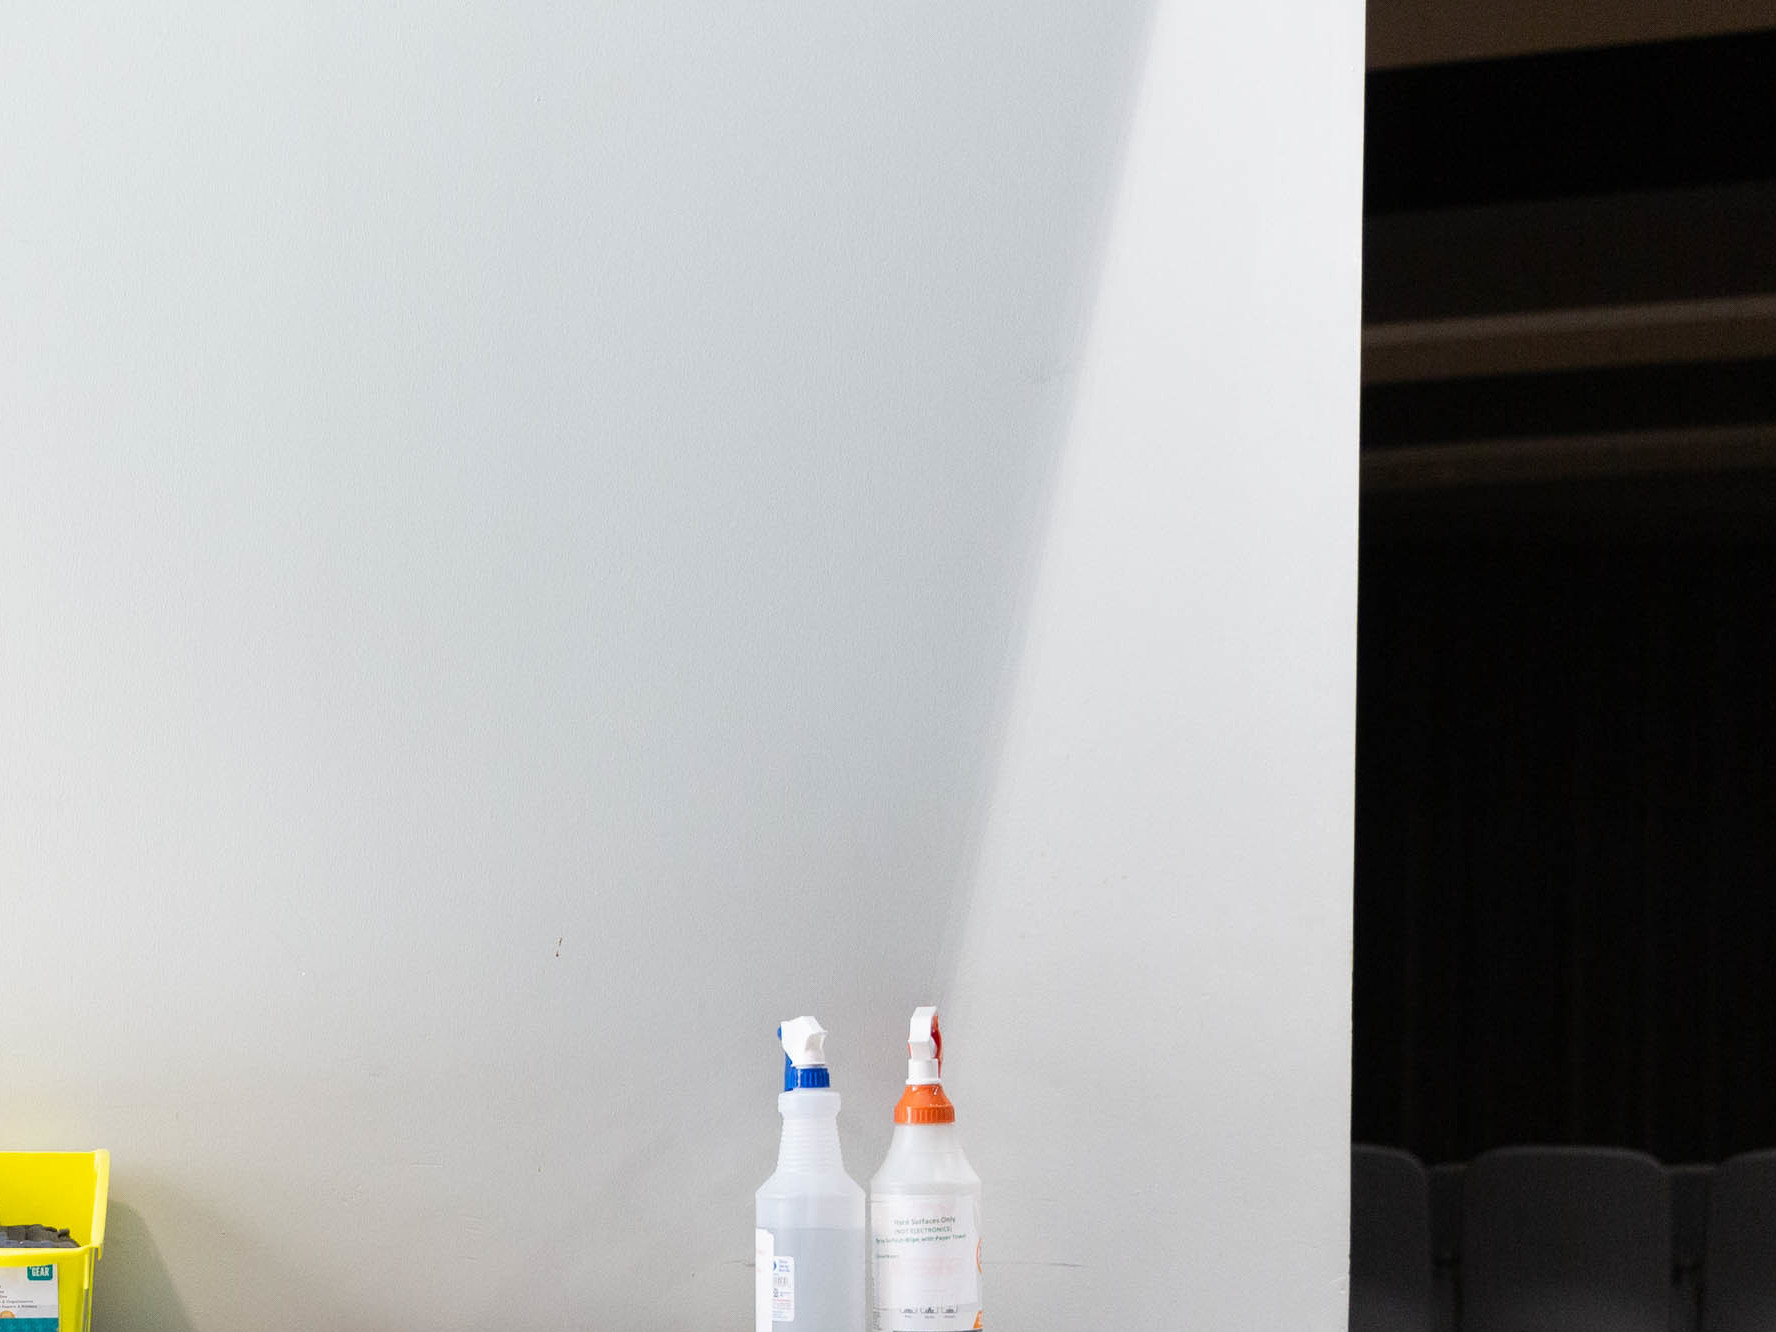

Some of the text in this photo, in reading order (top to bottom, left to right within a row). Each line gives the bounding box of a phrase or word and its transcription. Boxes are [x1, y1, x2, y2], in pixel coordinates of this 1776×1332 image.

[911, 1217, 940, 1225] Surfaces
[940, 1215, 956, 1224] Only
[31, 1267, 50, 1277] GEAR
